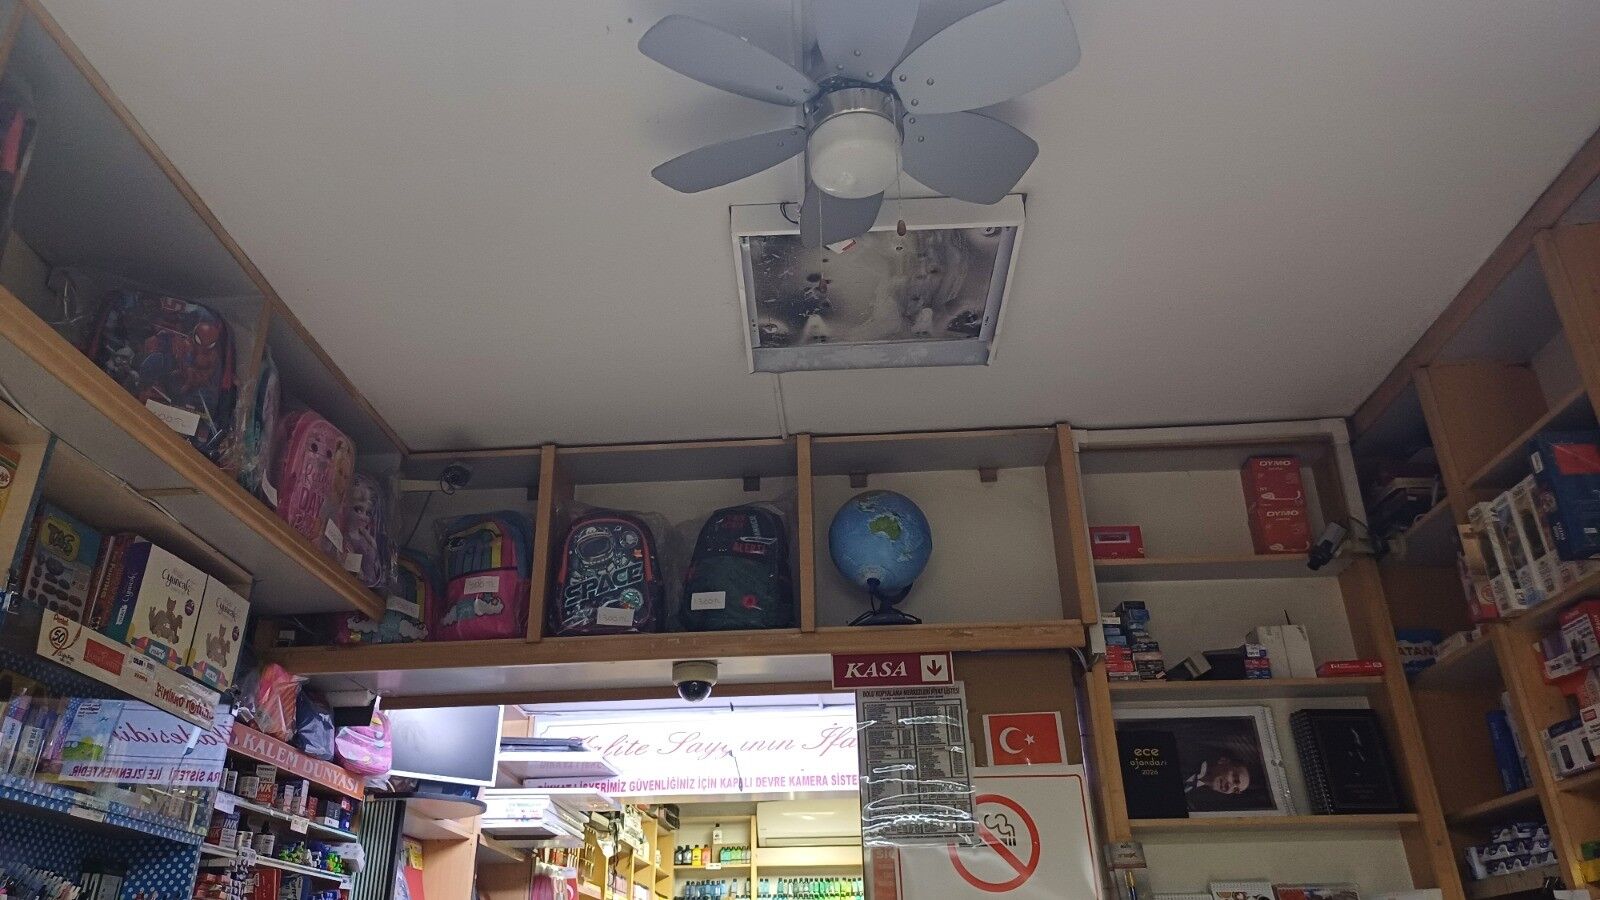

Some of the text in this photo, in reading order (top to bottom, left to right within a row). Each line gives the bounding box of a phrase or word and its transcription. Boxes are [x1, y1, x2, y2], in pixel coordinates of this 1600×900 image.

[565, 561, 644, 608] SPACE
[52, 630, 66, 643] 50
[844, 661, 908, 678] KASA
[802, 722, 857, 757] İfa
[1134, 748, 1159, 757] ece
[243, 733, 359, 794] KALEM DÜNYASI
[629, 776, 695, 792] GÜVENLİĞİNİZ
[697, 777, 717, 790] İÇİN
[755, 776, 786, 787] DEVRE
[789, 775, 828, 787] KAMERA
[831, 772, 858, 786] SİSTE
